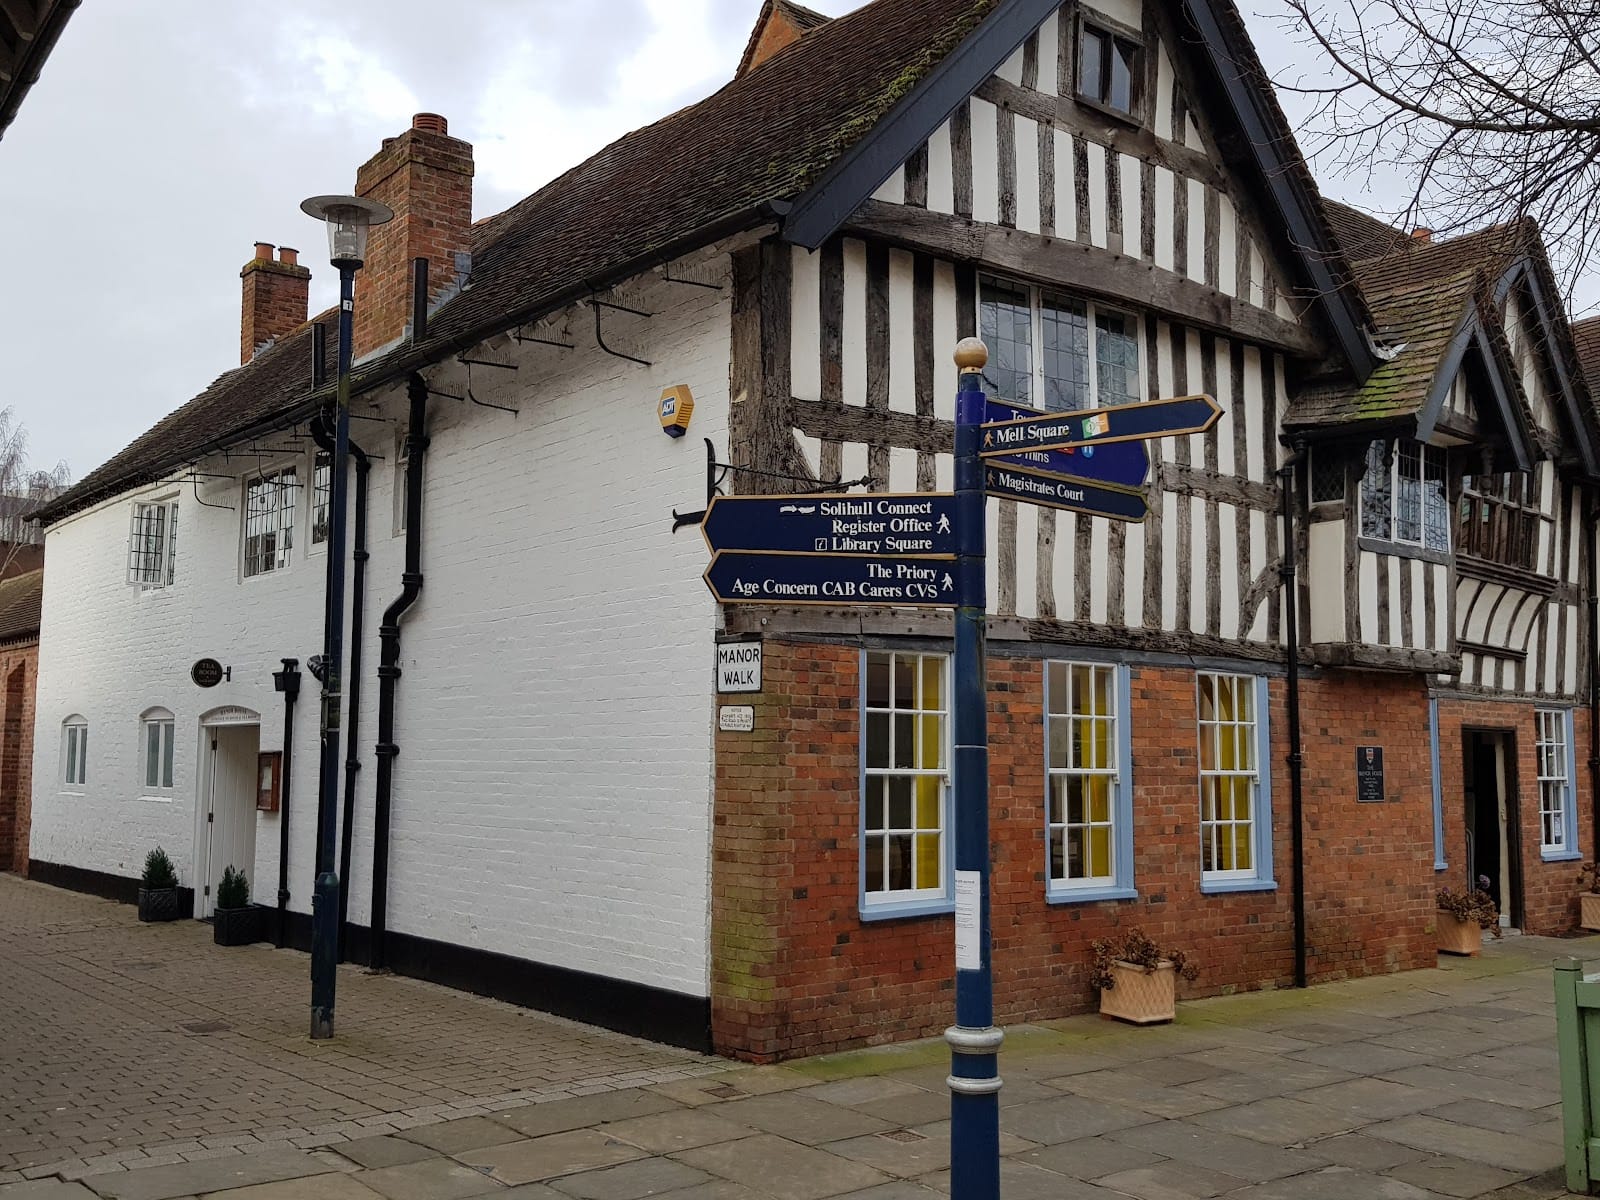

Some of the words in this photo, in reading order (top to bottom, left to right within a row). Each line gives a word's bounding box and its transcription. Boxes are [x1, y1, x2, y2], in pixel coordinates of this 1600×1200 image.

[996, 428, 1024, 444] Mell
[1027, 425, 1070, 442] Square
[998, 472, 1055, 496] Magistrates
[1056, 485, 1085, 502] Court
[820, 502, 873, 516] Solihull
[876, 501, 932, 514] Connect
[832, 519, 886, 535] Register
[890, 518, 932, 532] Office
[832, 537, 882, 553] Library
[885, 536, 932, 552] Square
[866, 563, 893, 578] The
[896, 564, 938, 582] Priory
[732, 578, 760, 596] Age
[763, 579, 818, 595] Concern
[821, 581, 856, 596] CAB
[859, 582, 902, 597] Carers
[905, 583, 938, 598] CVS
[719, 648, 760, 664] MANOR
[723, 670, 754, 685] WALK
